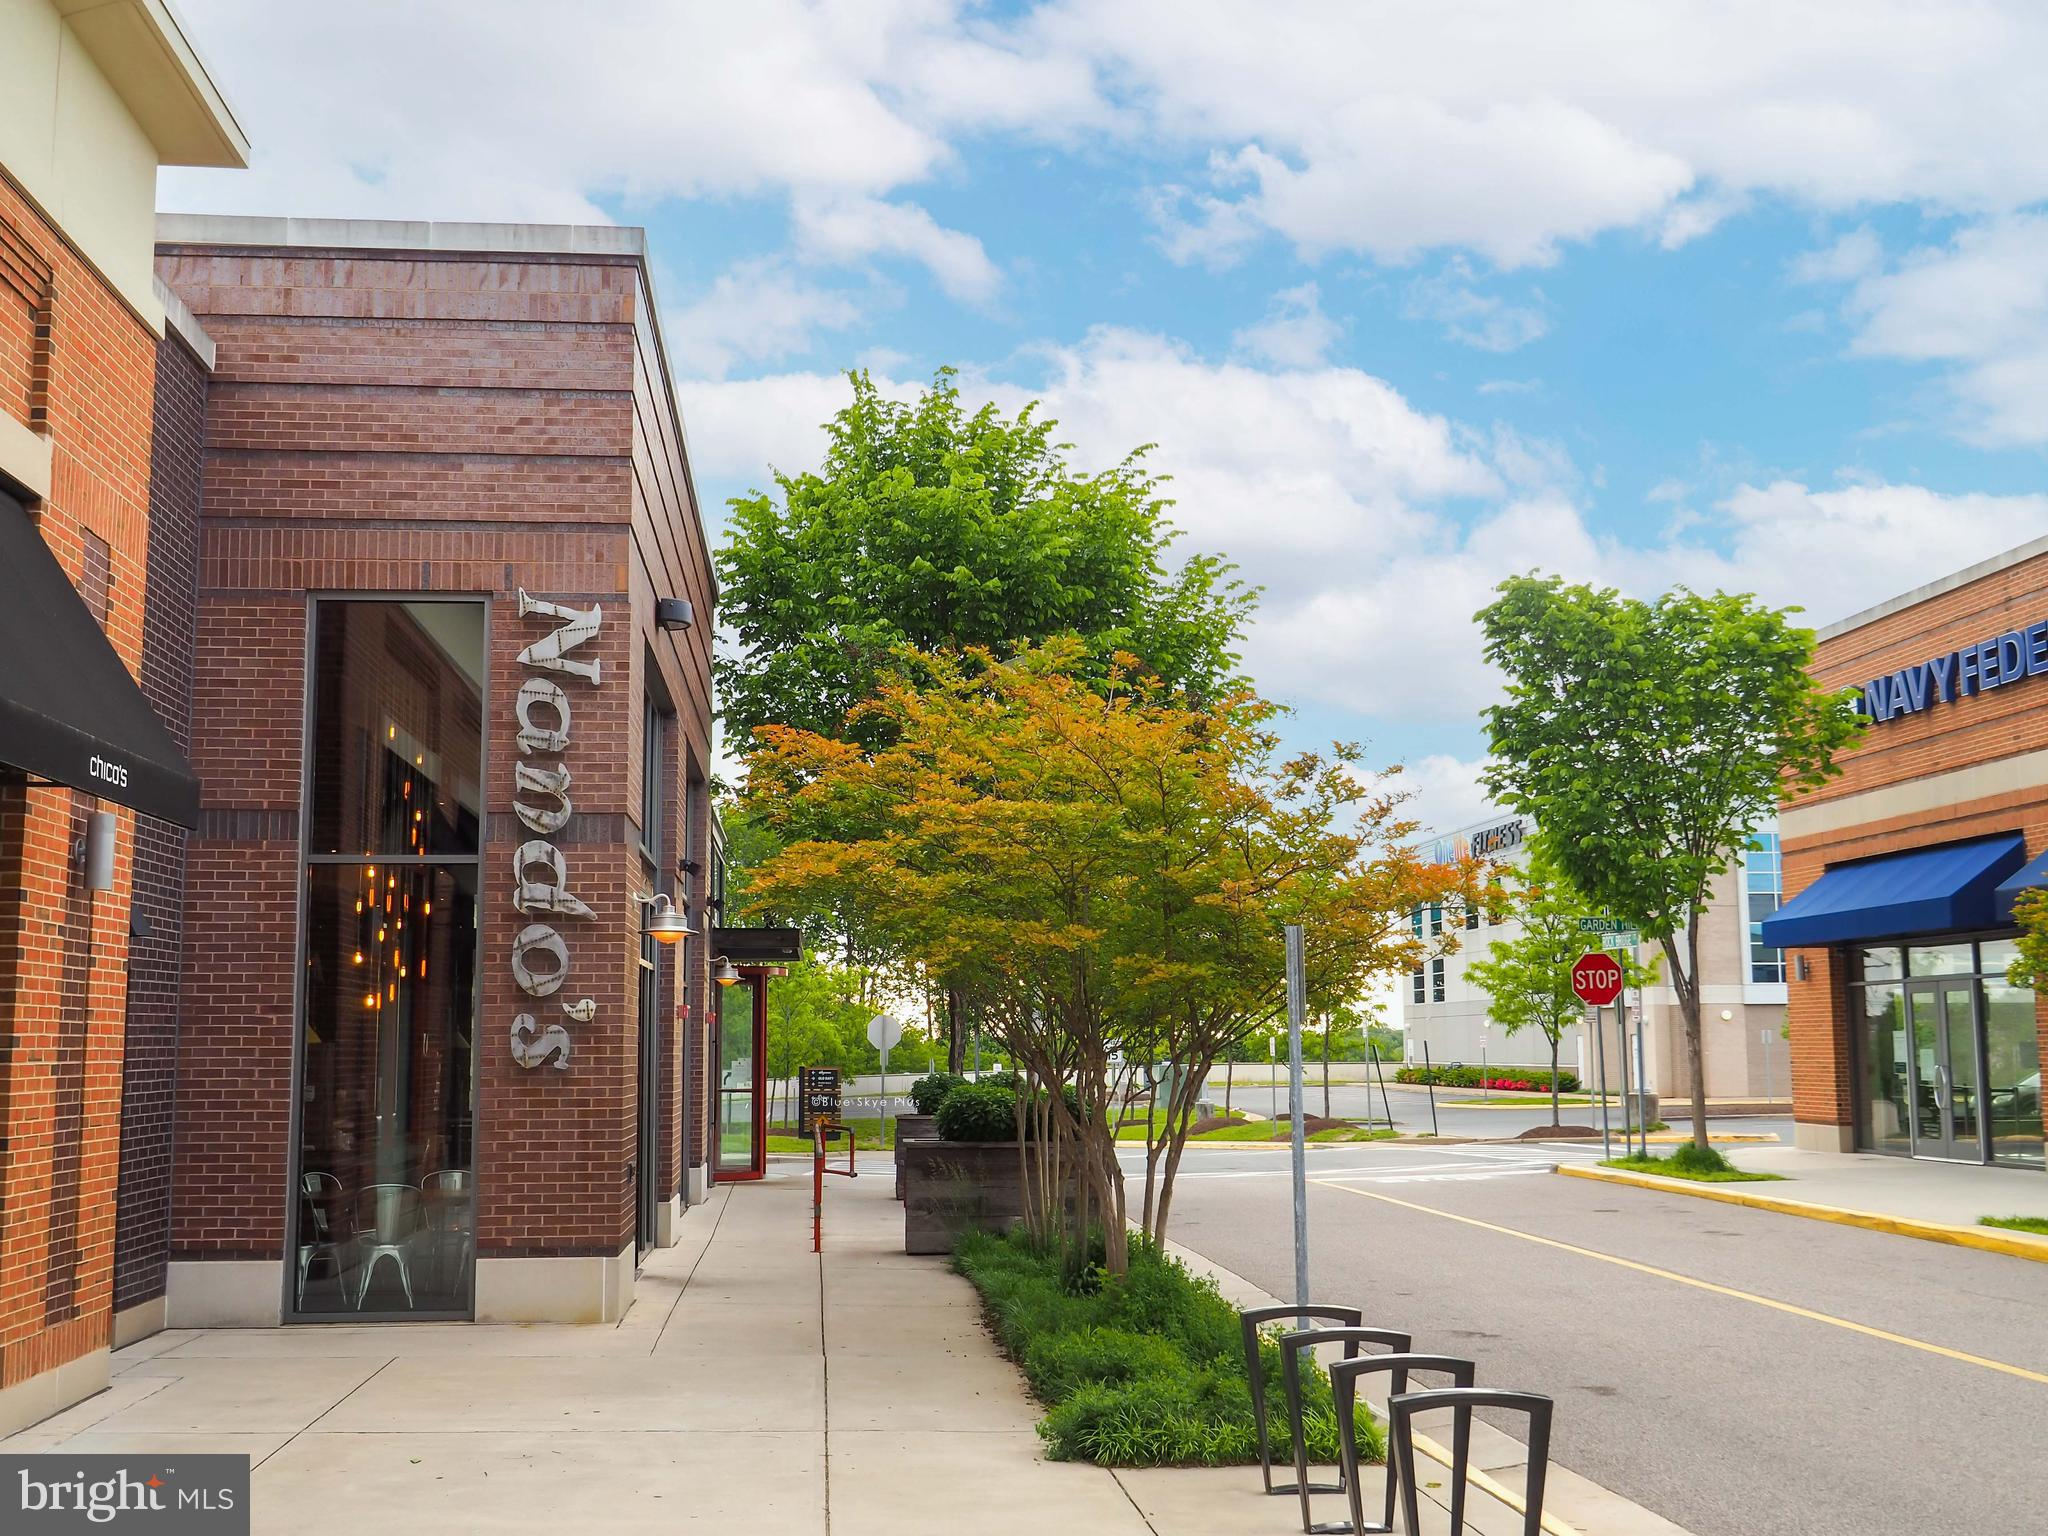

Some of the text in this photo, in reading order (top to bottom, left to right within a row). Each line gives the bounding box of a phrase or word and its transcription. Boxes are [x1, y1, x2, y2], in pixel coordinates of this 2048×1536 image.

[1864, 620, 2048, 726] NAVY FEDE
[89, 754, 128, 788] chico's
[510, 587, 602, 1070] Nando's
[1580, 919, 1617, 931] GARDEN
[1575, 969, 1619, 990] STOP
